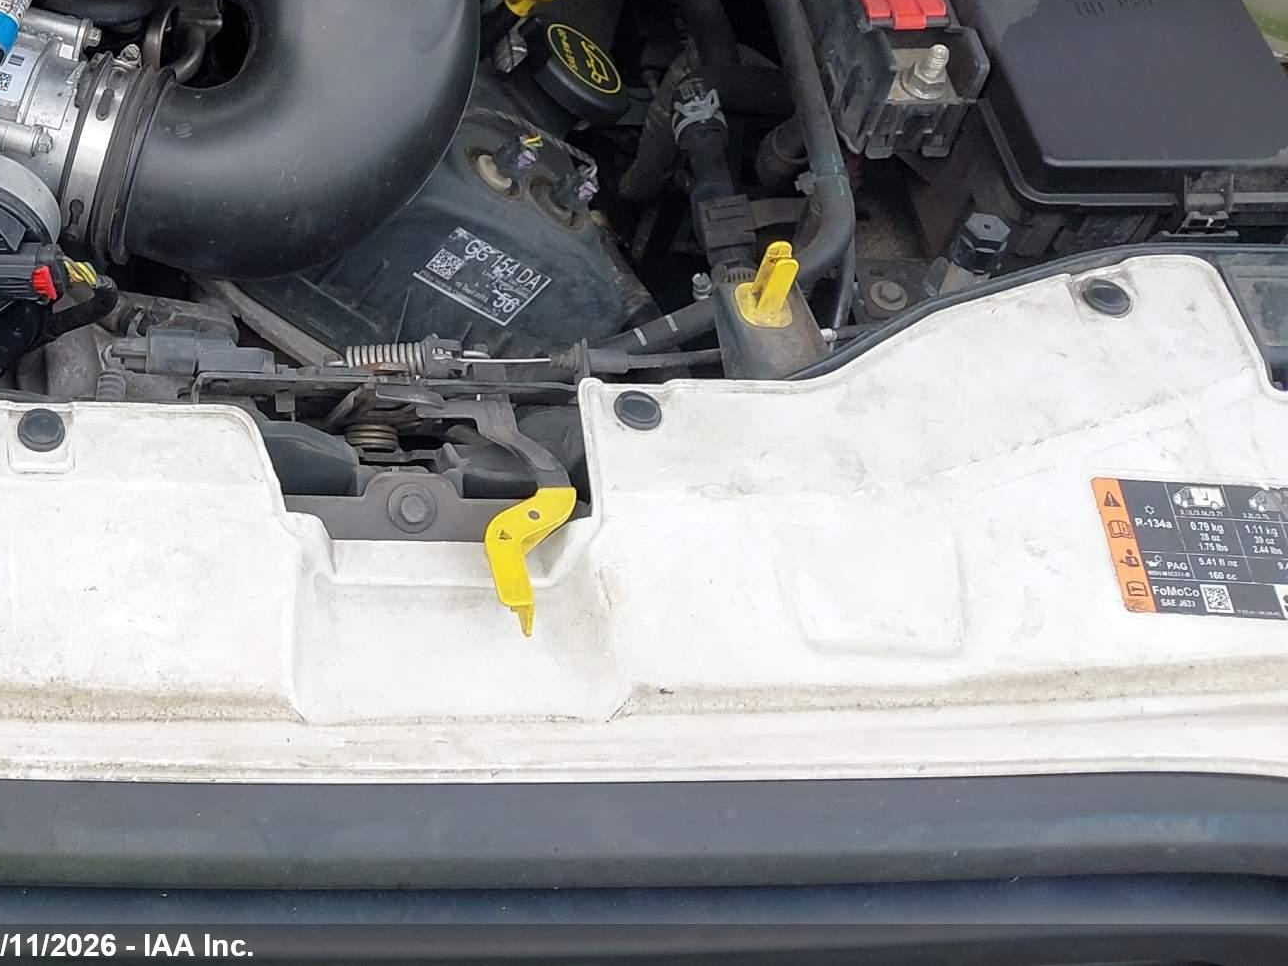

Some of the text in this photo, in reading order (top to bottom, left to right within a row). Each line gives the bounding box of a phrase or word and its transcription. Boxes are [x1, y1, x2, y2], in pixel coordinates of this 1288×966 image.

[491, 252, 521, 276] 154
[516, 266, 541, 290] DA
[1134, 517, 1172, 529] R-134a
[1190, 521, 1224, 534] 0.79 kg
[1244, 524, 1278, 537] 1.11 kg
[1198, 543, 1229, 552] 1.75 lbs
[1252, 545, 1283, 555] 2.44 lbs
[1166, 561, 1188, 571] PAG
[1198, 557, 1217, 566] 5.41
[1208, 571, 1225, 580] 160
[1152, 585, 1200, 597] FoMoCo
[1160, 598, 1177, 607] SAE
